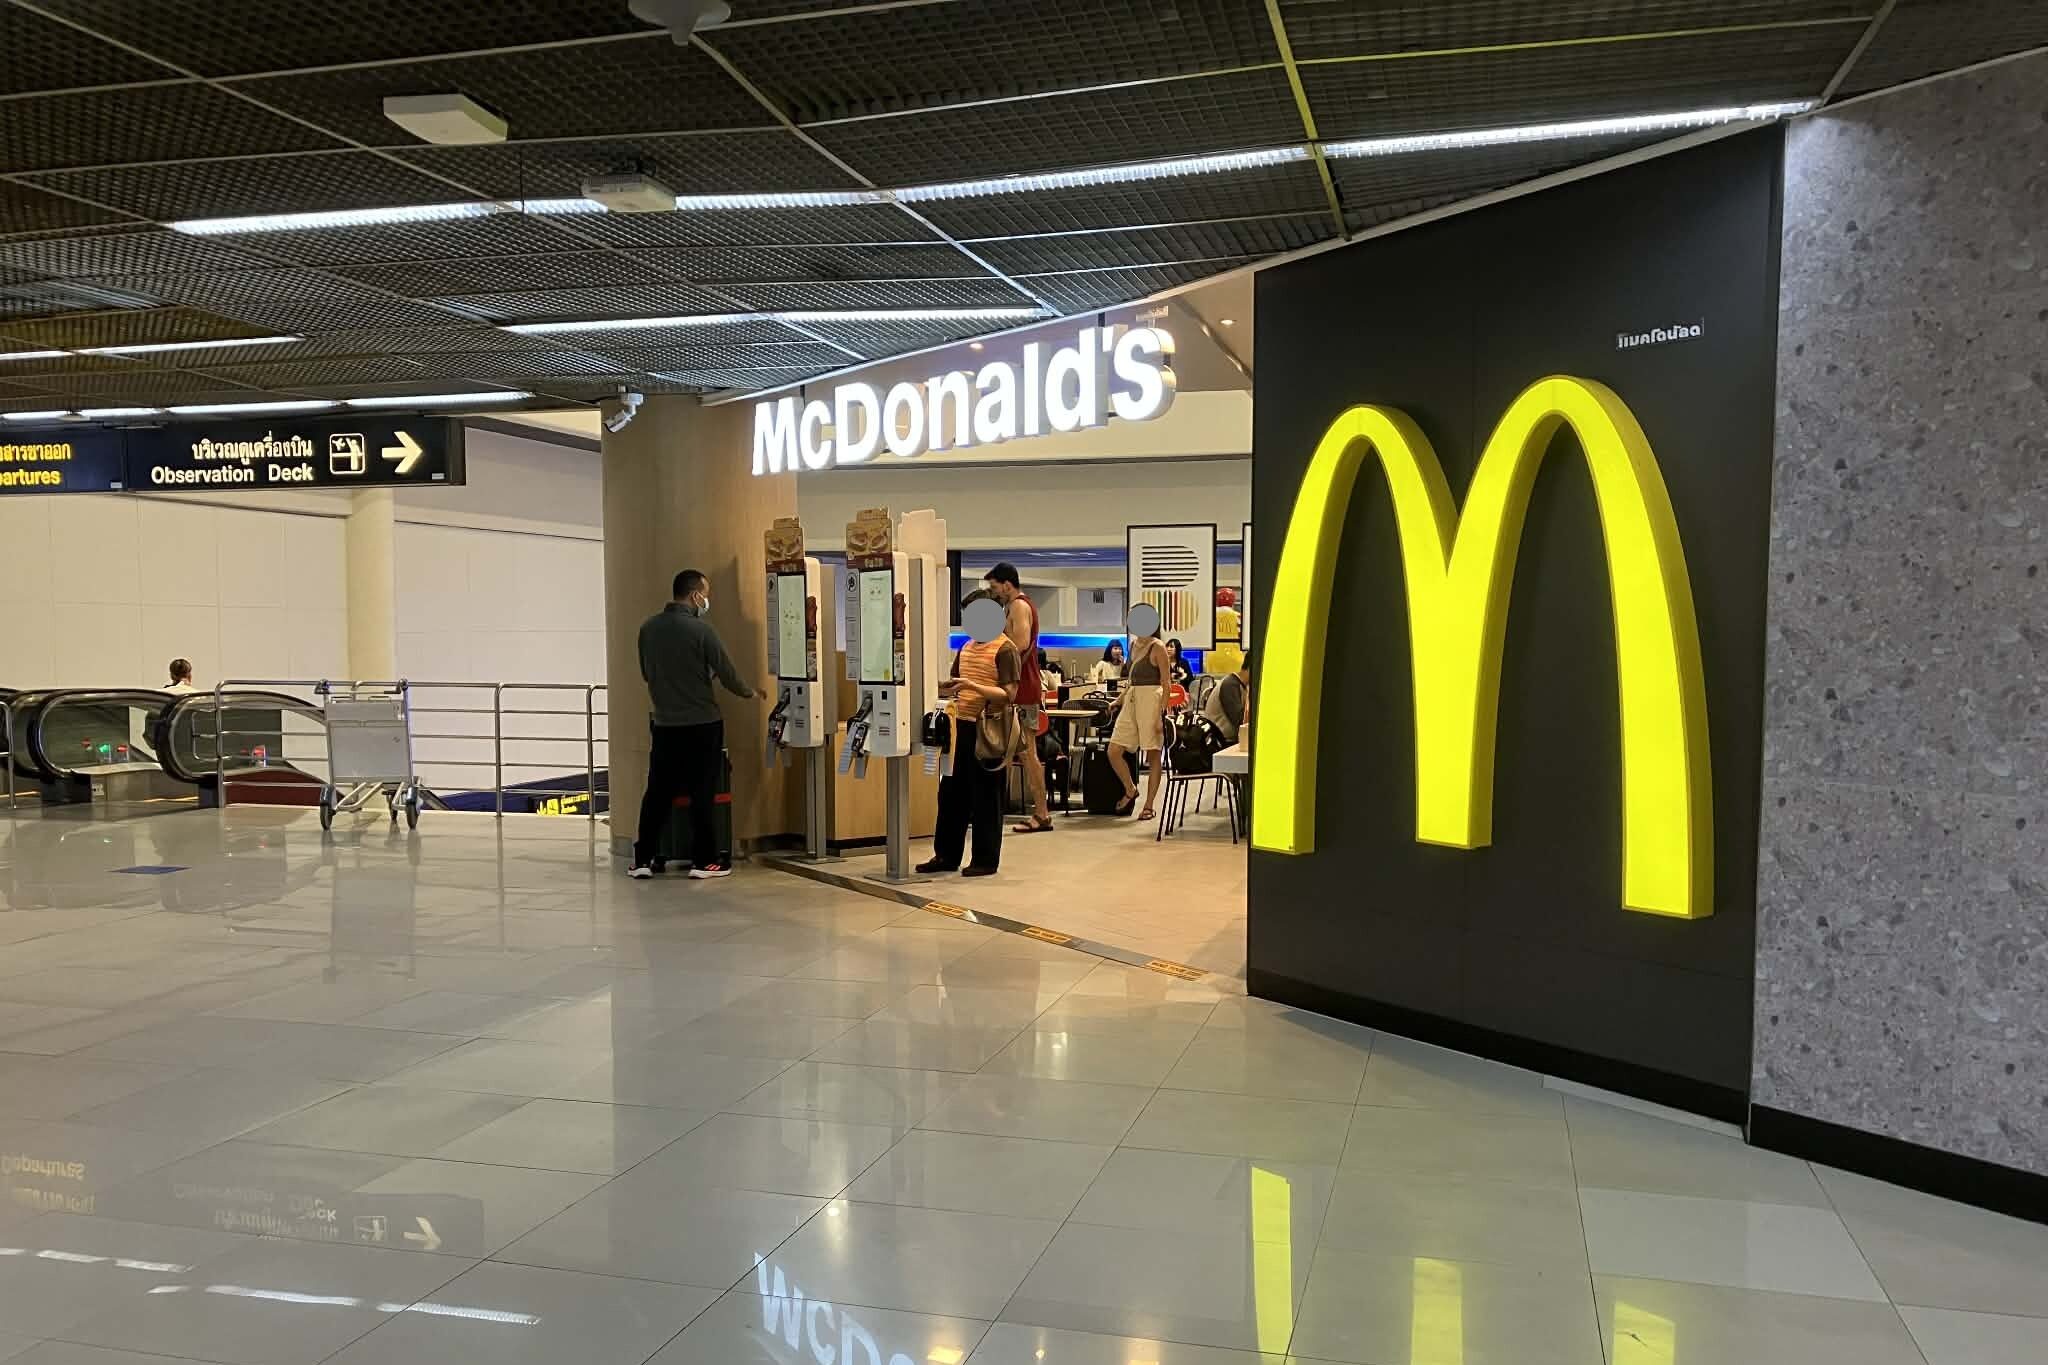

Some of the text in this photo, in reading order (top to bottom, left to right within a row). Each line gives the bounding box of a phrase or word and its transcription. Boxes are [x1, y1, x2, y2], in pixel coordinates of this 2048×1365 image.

[752, 326, 1176, 476] McDonald's
[0, 443, 72, 462] สารขาออก
[191, 430, 314, 465] บริเวณดูเครื่องบิน
[0, 467, 61, 486] artures
[151, 462, 314, 484] Observation Deck
